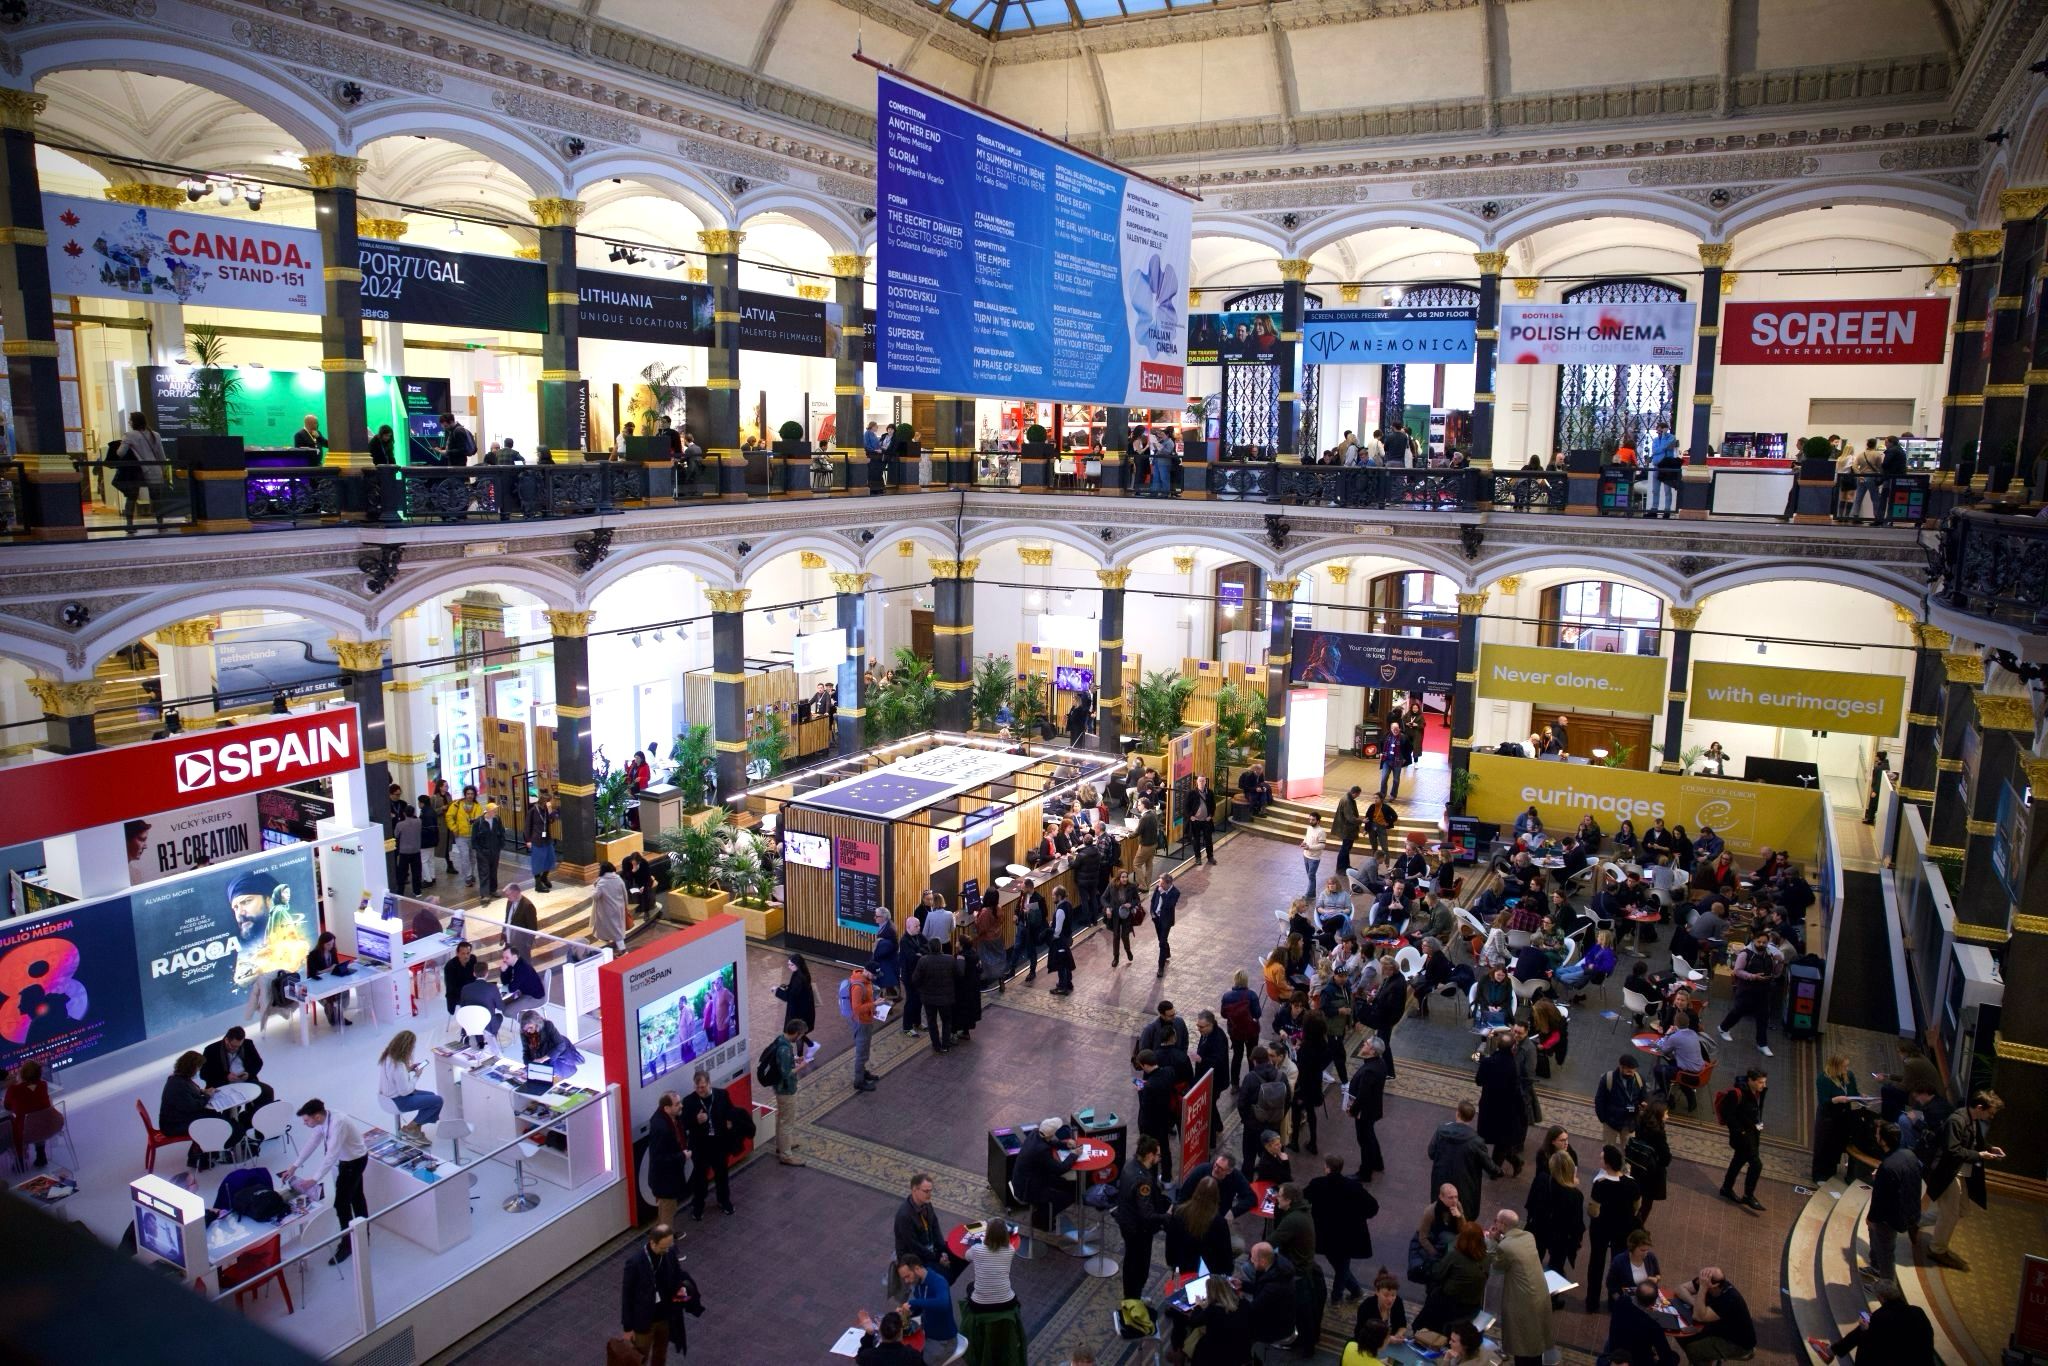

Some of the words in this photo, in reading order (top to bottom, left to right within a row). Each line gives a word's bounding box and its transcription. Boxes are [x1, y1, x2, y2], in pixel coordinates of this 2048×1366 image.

[888, 100, 926, 120] COMPETITION
[888, 117, 924, 137] ANOTHER
[925, 130, 941, 142] END
[888, 130, 895, 141] by
[897, 132, 910, 145] Piero
[912, 138, 932, 152] Messina
[976, 134, 1005, 151] GENERATION
[888, 147, 919, 165] GLORIA!
[986, 152, 1012, 168] SUMMER
[1013, 161, 1027, 174] WITH
[888, 160, 896, 171] by
[897, 164, 925, 179] Margherita
[976, 160, 1016, 183] QUELL'ESTATE
[1018, 176, 1030, 187] CON
[888, 194, 908, 206] FORUM
[888, 210, 902, 222] THE
[904, 214, 931, 229] SECRET
[933, 222, 963, 237] DRAWER
[975, 212, 994, 222] ITALIAN
[888, 223, 894, 233] IL
[896, 225, 931, 242] CASSETTO
[932, 233, 962, 250] SEGRETO
[974, 220, 1015, 237] CO-PRODUCTIONS
[168, 229, 312, 270] CANADA.
[888, 237, 895, 246] by
[896, 239, 920, 251] Costanza
[974, 240, 1006, 253] COMPETITION
[358, 250, 464, 284] PORTUGAL
[976, 251, 986, 263] THE
[988, 255, 1011, 268] EMPIRE
[218, 266, 274, 284] STAND
[281, 272, 304, 287] 151
[888, 270, 917, 283] BERLINALE
[918, 276, 939, 287] SPECIAL
[360, 274, 402, 300] 2024
[888, 286, 937, 303] DOSTOEVSKIJ
[580, 288, 652, 309] LITHUANIA
[888, 299, 895, 309] by
[896, 301, 919, 311] Damiano
[925, 305, 939, 315] Fabio
[580, 311, 624, 324] UNIQUE
[630, 316, 688, 330] LOCATIONS
[740, 306, 776, 322] LATVIA
[888, 310, 920, 322] D'Innocenzo
[974, 313, 991, 323] TURN
[992, 315, 999, 325] IN
[1000, 317, 1010, 328] THE
[1012, 319, 1035, 331] WOUND
[741, 326, 776, 338] TALENTED
[779, 329, 822, 344] FILMMAKERS
[888, 327, 924, 340] SUPERSEX
[1148, 328, 1170, 342] ITALIAN
[1510, 326, 1580, 341] POLISH
[1587, 325, 1666, 341] CINEMA
[1751, 310, 1917, 346] SCREEN
[888, 340, 895, 349] by
[896, 340, 914, 351] Matteo
[991, 348, 1015, 358] EXPANDED
[1156, 342, 1177, 354] CINEMA
[1350, 338, 1467, 352] MNEMONICA
[888, 351, 914, 362] Francesco
[888, 362, 914, 372] Francesca
[915, 364, 940, 374] Mazzoleni
[973, 359, 980, 368] IN
[981, 360, 1002, 370] PRAISE
[1004, 362, 1012, 371] OF
[1014, 364, 1043, 375] SLOWNESS
[220, 646, 235, 654] the
[221, 650, 276, 664] netherlands
[1372, 652, 1386, 661] king.
[1403, 656, 1435, 664] kingdom.
[1492, 665, 1552, 685] Never
[1554, 671, 1624, 692] alone...
[1706, 686, 1753, 705] with
[1758, 692, 1884, 719] eurimages!
[218, 722, 349, 783] SPAIN
[1681, 784, 1714, 793] COUNCIL
[1730, 791, 1756, 799] EUROPE
[1521, 784, 1665, 822] eurimages
[170, 818, 200, 832] VICKY
[201, 810, 232, 826] KRIEPS
[253, 866, 269, 875] MINA
[280, 857, 307, 868] HAMMANI
[172, 887, 195, 898] MORTE
[180, 922, 196, 930] FACED
[196, 918, 211, 927] ONLY
[185, 916, 200, 924] HELL
[194, 921, 216, 932] BRAVE
[0, 932, 30, 948] JULIO
[32, 920, 74, 939] MEDEM
[181, 939, 206, 950] GERARDO
[151, 935, 242, 979] RAQQA
[182, 968, 197, 979] SPY
[202, 961, 217, 973] SPY
[630, 967, 655, 983] Cinema
[188, 973, 214, 986] UPCOMING
[631, 981, 645, 992] from
[650, 968, 672, 983] SPAIN
